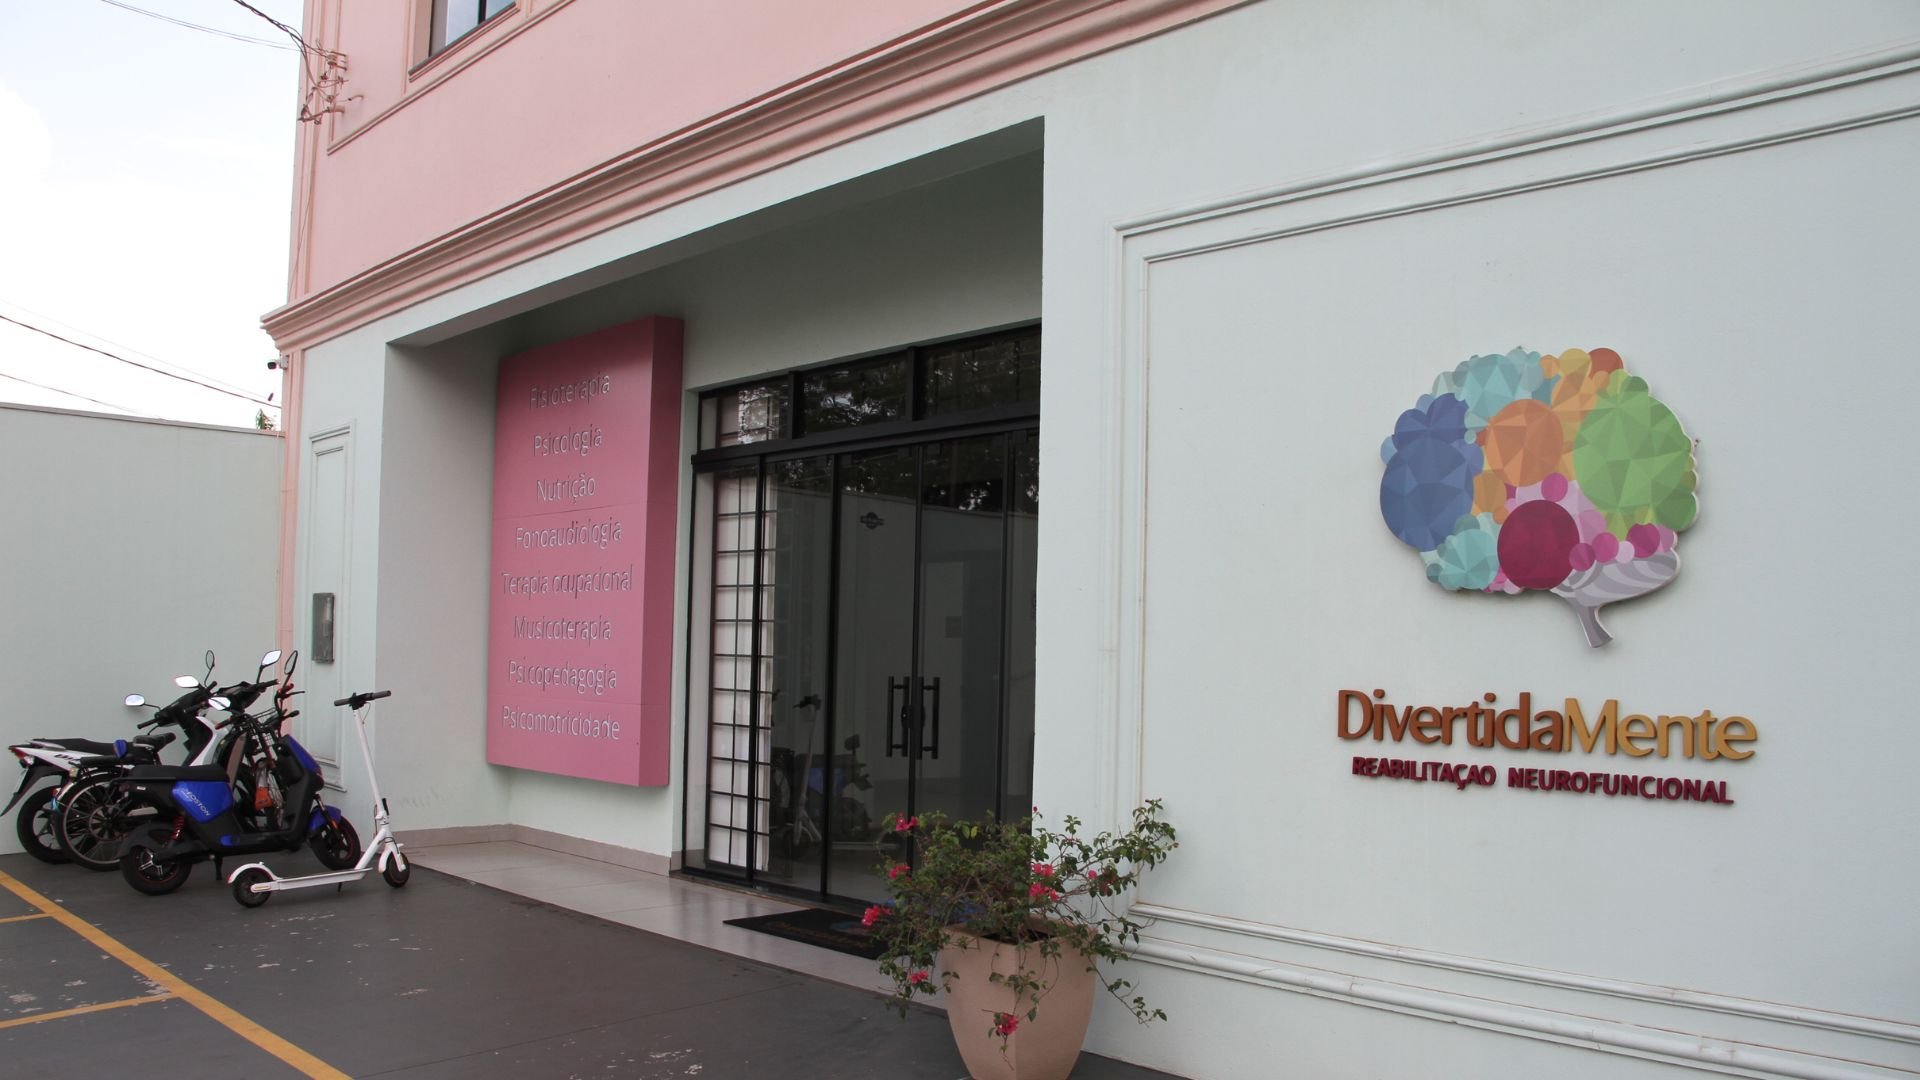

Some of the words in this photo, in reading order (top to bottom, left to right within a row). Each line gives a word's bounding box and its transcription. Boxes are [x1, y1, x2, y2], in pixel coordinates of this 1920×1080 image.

[529, 372, 611, 410] Fisioterapia
[533, 424, 602, 457] Psicologia
[536, 472, 596, 504] Nutrição
[515, 516, 622, 550] Fonoaudiologia
[502, 569, 549, 600] Terapia
[552, 563, 633, 600] ocupacional
[513, 615, 612, 648] Musicoterapia
[508, 656, 617, 696] Psicopedagogia
[503, 705, 620, 740] Psicomotricidade
[1337, 688, 1759, 761] DivertidaMente
[1507, 767, 1735, 804] NEUROFUNCIONAL
